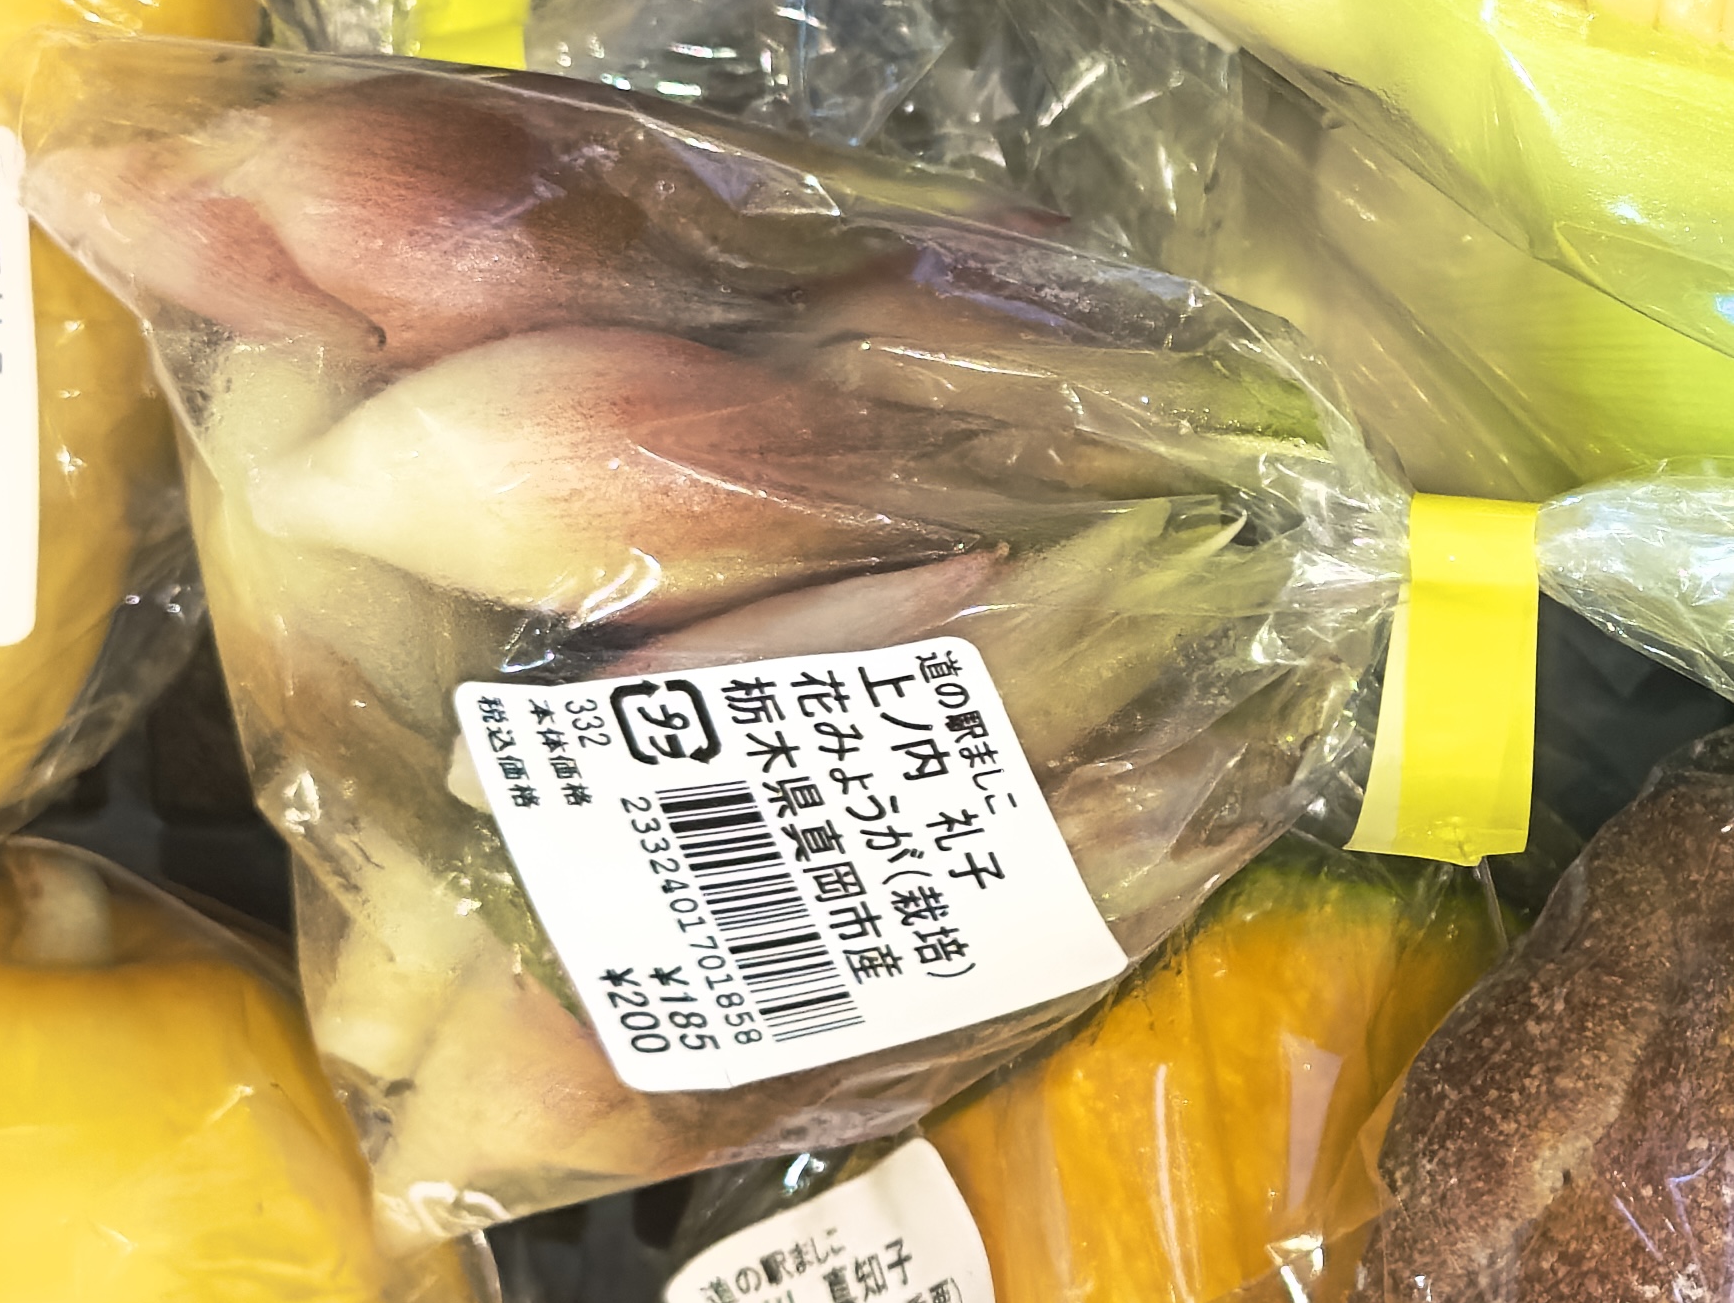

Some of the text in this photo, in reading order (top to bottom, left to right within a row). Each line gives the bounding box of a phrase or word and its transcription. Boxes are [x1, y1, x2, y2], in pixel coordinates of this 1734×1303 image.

[563, 697, 613, 750] 332
[721, 675, 904, 986] 栃木県真岡市産
[914, 649, 1019, 816] 道の駅ましこ
[924, 807, 1005, 891] 礼子
[476, 695, 672, 1055] 税込価格 ¥200
[527, 698, 722, 1052] 本体価格 ¥185
[619, 795, 764, 1046] 2332401701858
